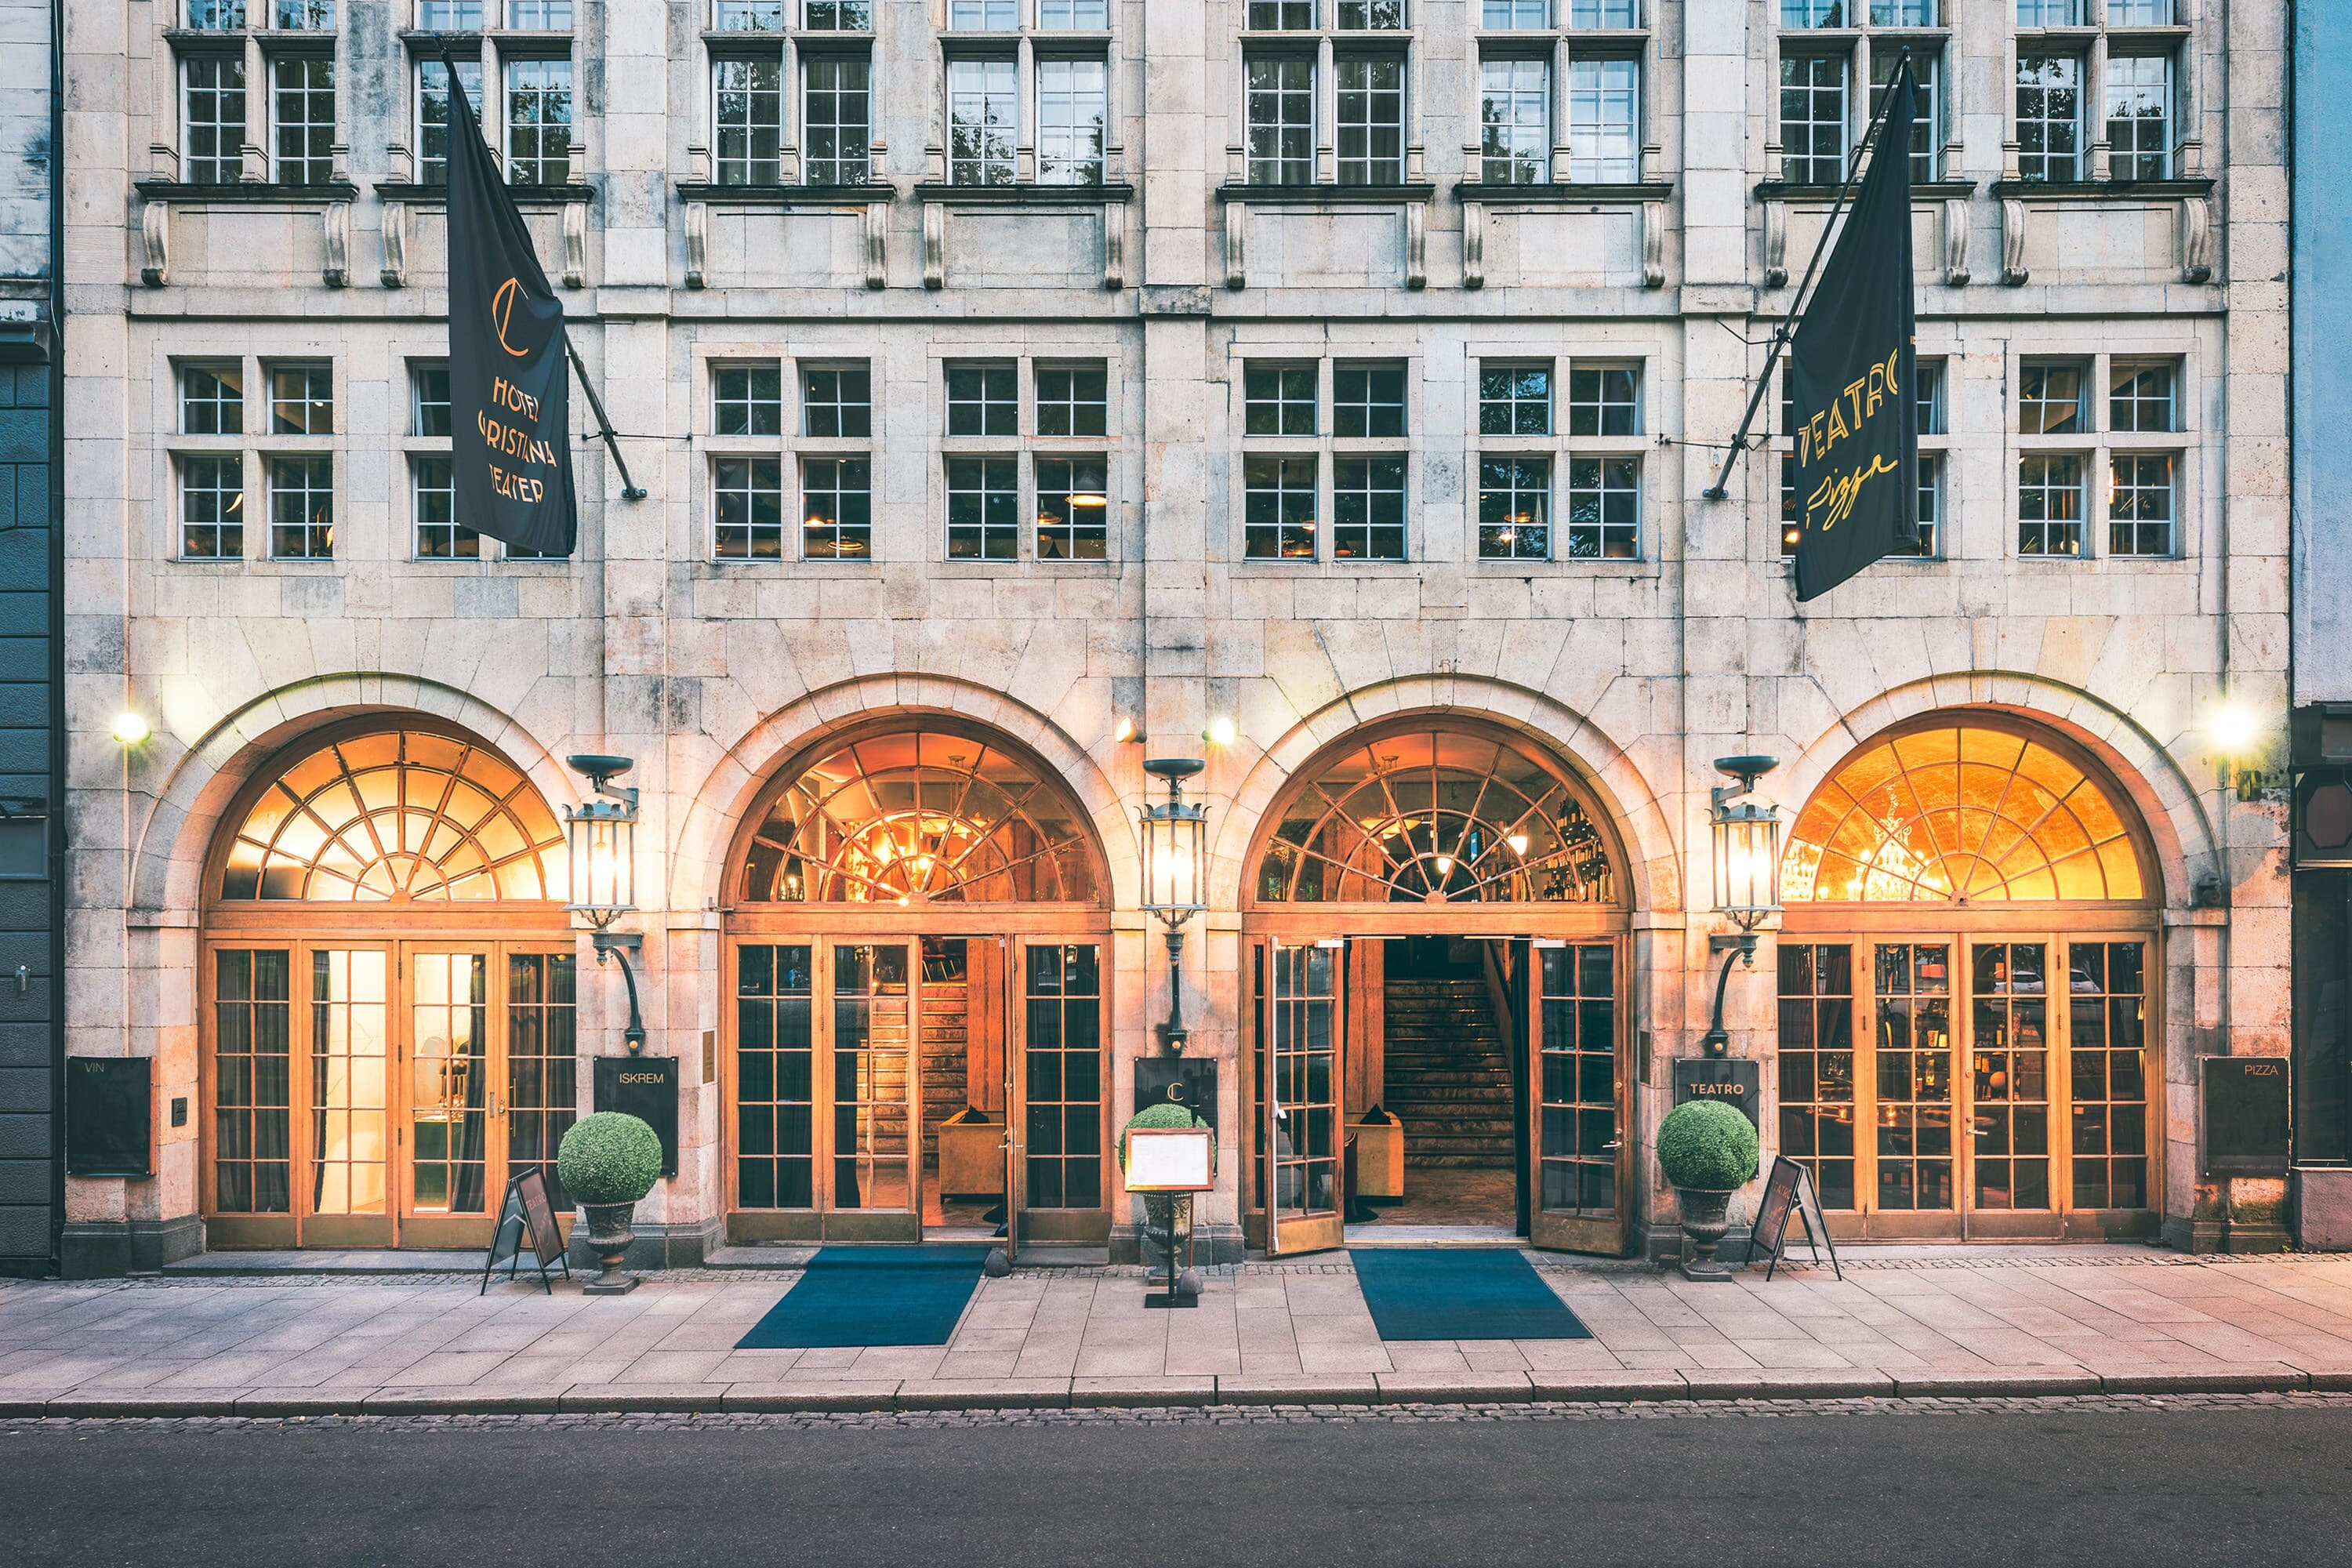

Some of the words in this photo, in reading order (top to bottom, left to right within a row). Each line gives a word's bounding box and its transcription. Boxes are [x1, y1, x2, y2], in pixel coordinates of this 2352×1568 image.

[492, 376, 539, 423] HOTEL
[84, 1062, 105, 1073] VIN
[2245, 1065, 2279, 1076] PIZZA
[619, 1073, 664, 1084] ISKREM
[1690, 1083, 1744, 1094] TEATRO
[525, 1192, 547, 1211] TEATRO
